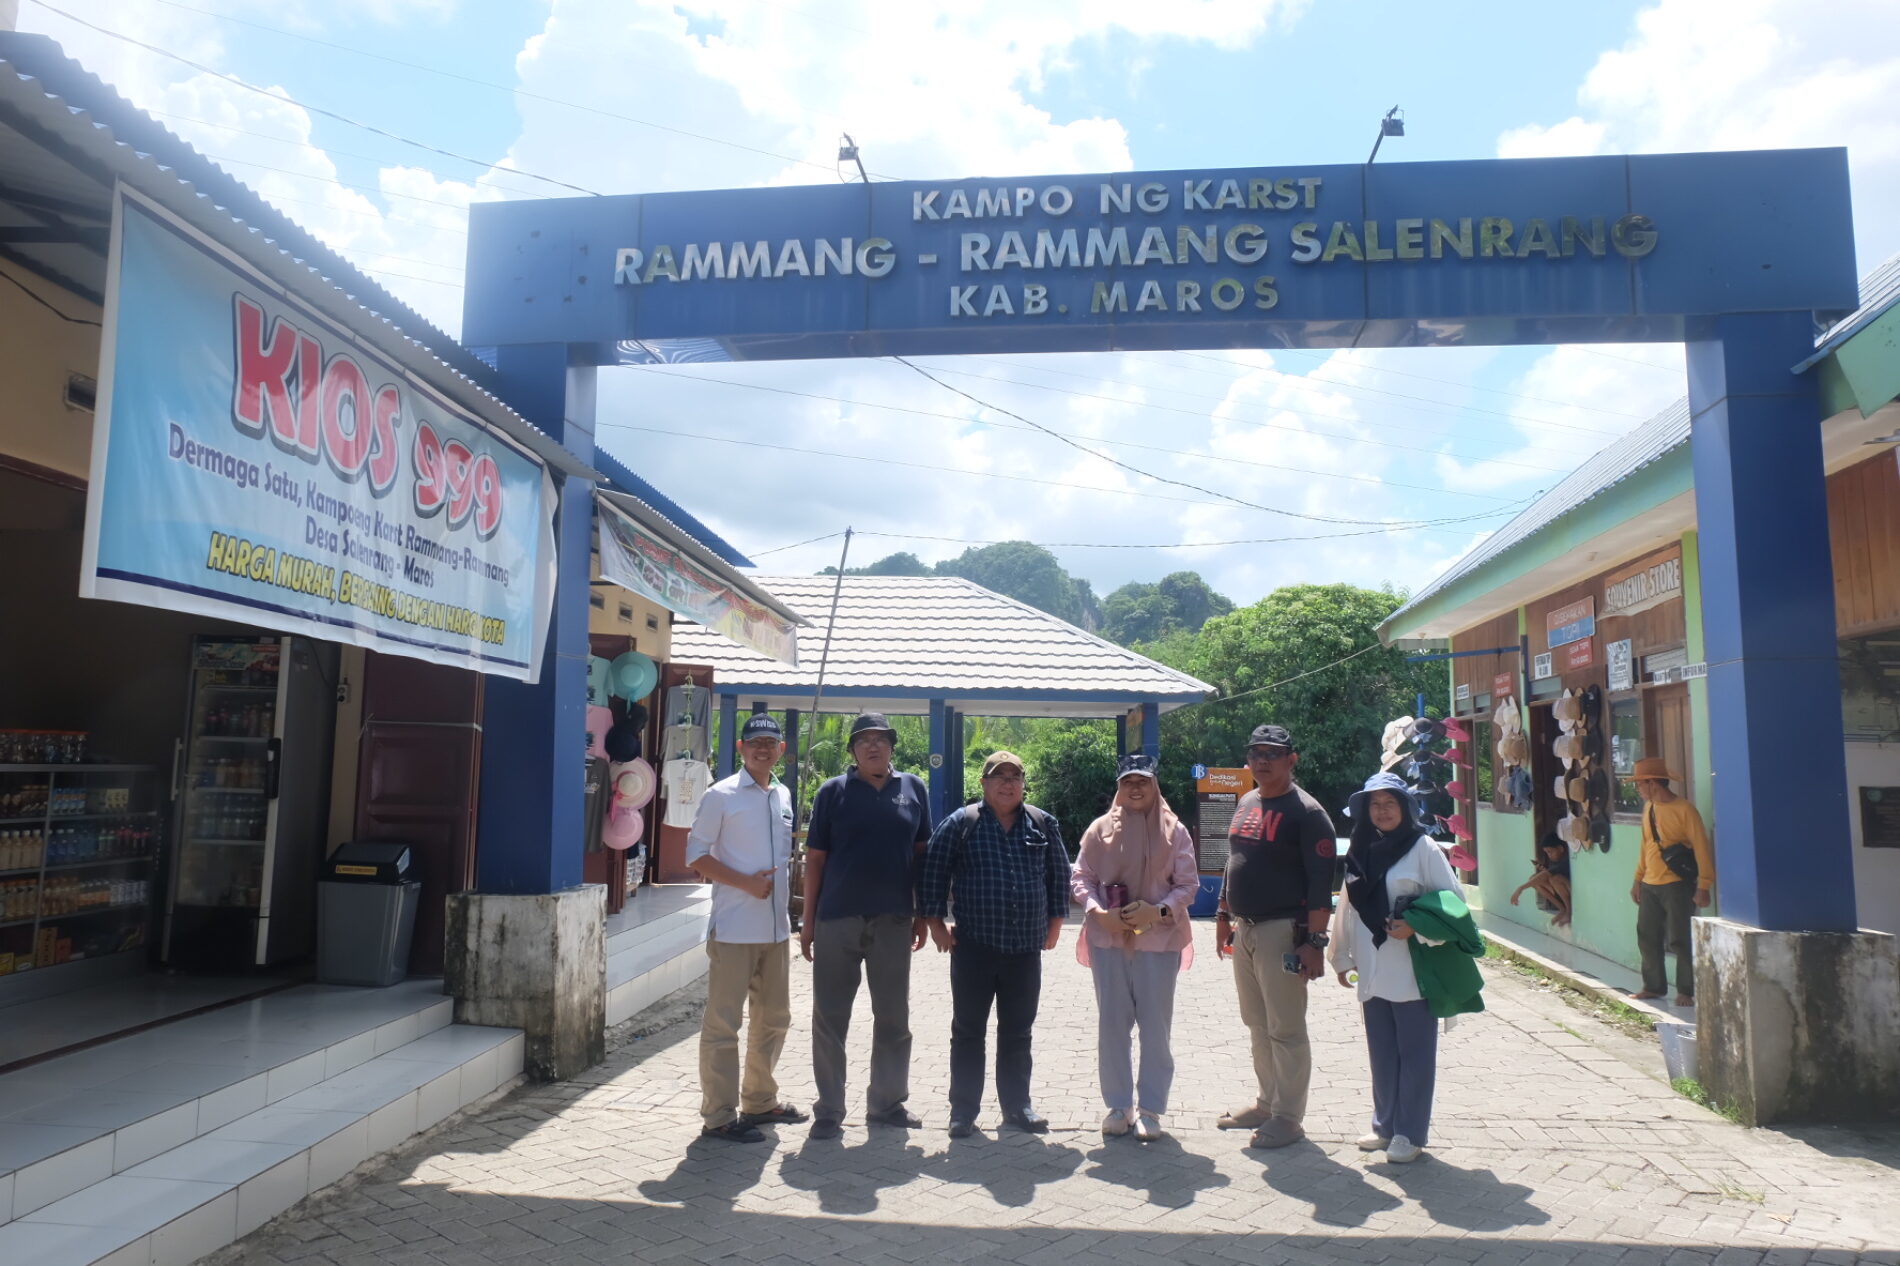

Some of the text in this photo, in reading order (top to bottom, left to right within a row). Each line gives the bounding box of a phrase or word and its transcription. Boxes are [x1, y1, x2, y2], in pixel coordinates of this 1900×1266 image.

[1183, 176, 1322, 211] KARST
[614, 237, 896, 286] RAMMANG
[961, 223, 1268, 272] RAMMANG
[1290, 213, 1659, 264] SALENRANG
[949, 275, 1279, 318] KAB. MAROS
[231, 291, 503, 543] KIOS 999
[169, 422, 260, 488] Dermaga
[264, 462, 302, 508] Satu,
[306, 480, 371, 537] Kampoeng
[374, 510, 403, 547] Karst
[207, 530, 276, 584] HARGA
[276, 552, 336, 605] MURAH,
[397, 590, 446, 630] DENGAN
[305, 515, 338, 553] Desa
[343, 529, 395, 578] Salenrang
[404, 555, 434, 588] Maros
[1606, 558, 1680, 611] SOUVENIR STORE
